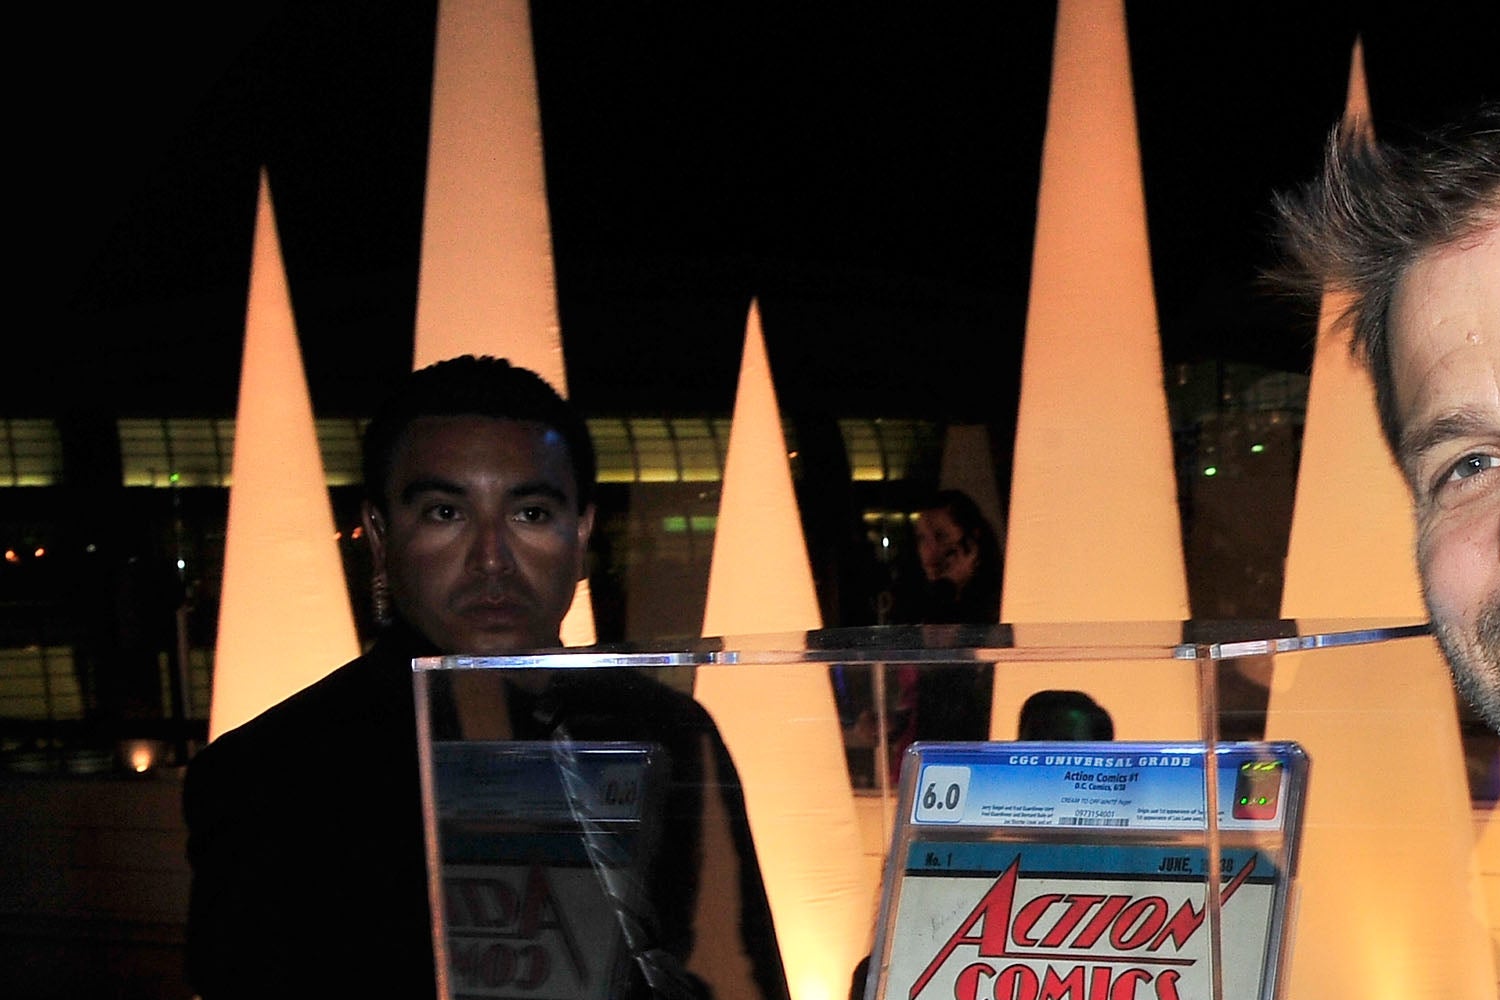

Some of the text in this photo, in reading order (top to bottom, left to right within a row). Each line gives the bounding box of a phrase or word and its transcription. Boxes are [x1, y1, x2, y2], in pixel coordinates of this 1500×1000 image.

[1009, 756, 1191, 768] CGC UNIVERSAL GRADE
[1064, 771, 1139, 783] Action Comics #1
[922, 783, 961, 810] 6.0
[926, 852, 953, 867] No. 1
[1158, 857, 1193, 873] JUNE,
